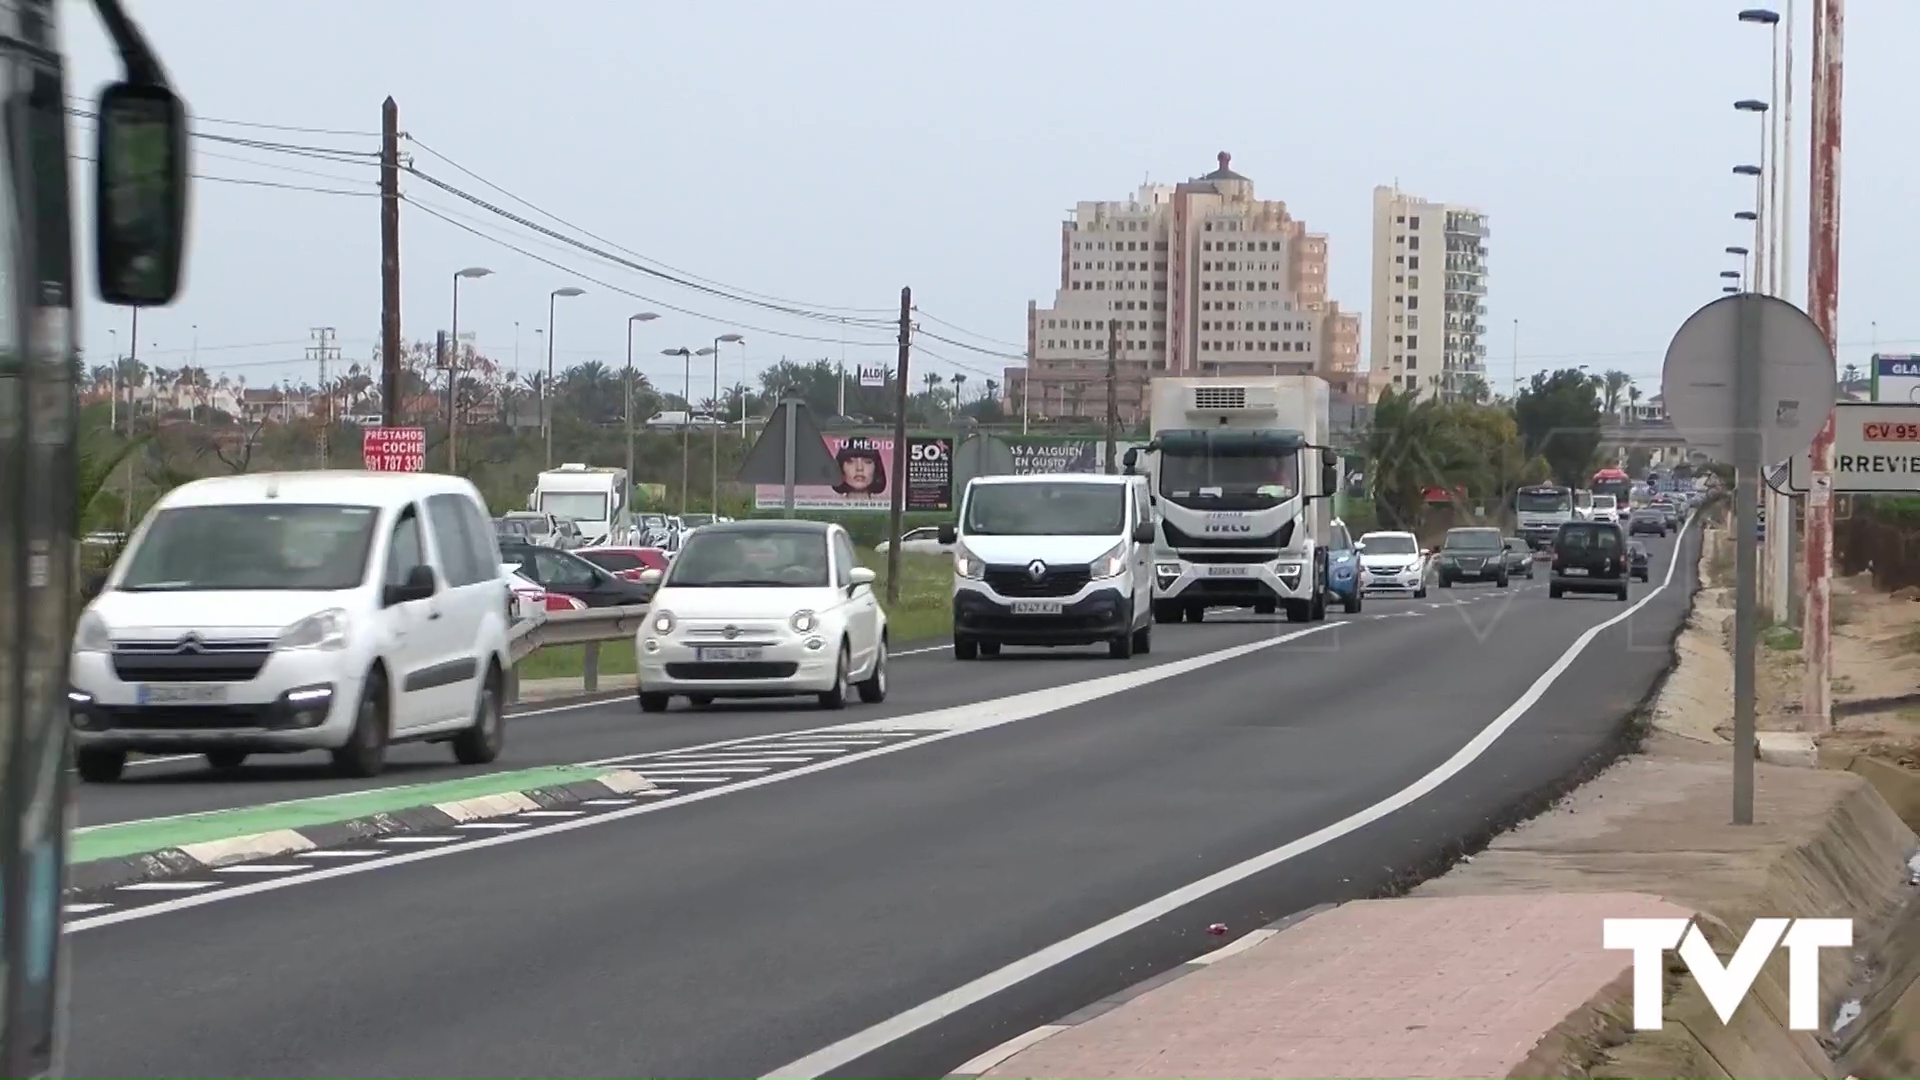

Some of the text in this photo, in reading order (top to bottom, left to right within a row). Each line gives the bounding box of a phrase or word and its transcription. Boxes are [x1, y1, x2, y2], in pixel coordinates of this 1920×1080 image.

[862, 368, 883, 378] ALDI
[1892, 363, 1920, 374] GLA
[1866, 424, 1920, 438] CV 95
[382, 442, 424, 453] COCHE
[833, 439, 894, 450] TU MEDID
[1026, 445, 1034, 455] A
[1037, 445, 1082, 456] ALGUIEN
[405, 455, 423, 471] 330
[1031, 457, 1066, 468] GUSTO
[1834, 455, 1920, 473] RREVIE
